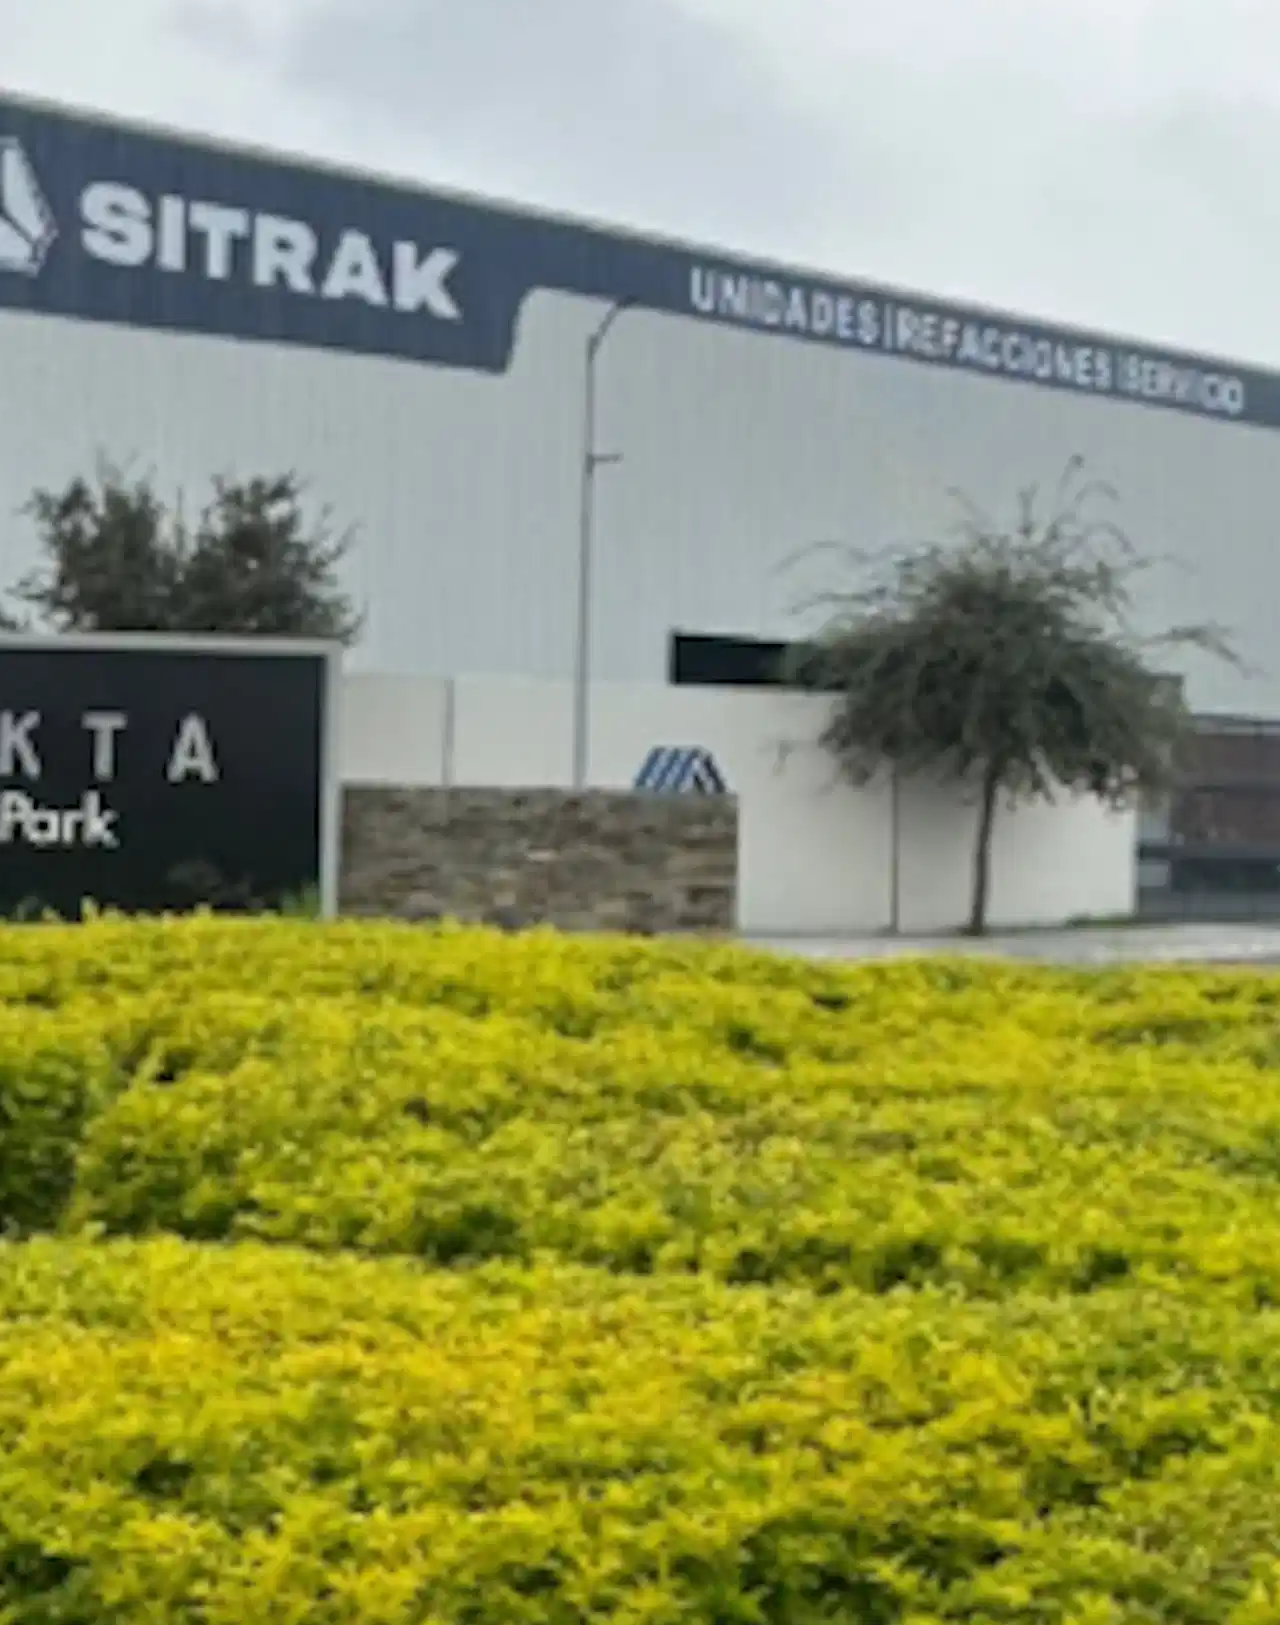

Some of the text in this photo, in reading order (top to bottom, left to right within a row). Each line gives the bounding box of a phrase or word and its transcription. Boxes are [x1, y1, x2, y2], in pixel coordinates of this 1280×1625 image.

[79, 180, 461, 321] SITRAK
[690, 265, 880, 346] UNIDADES
[896, 306, 1112, 391] REFACCIONES
